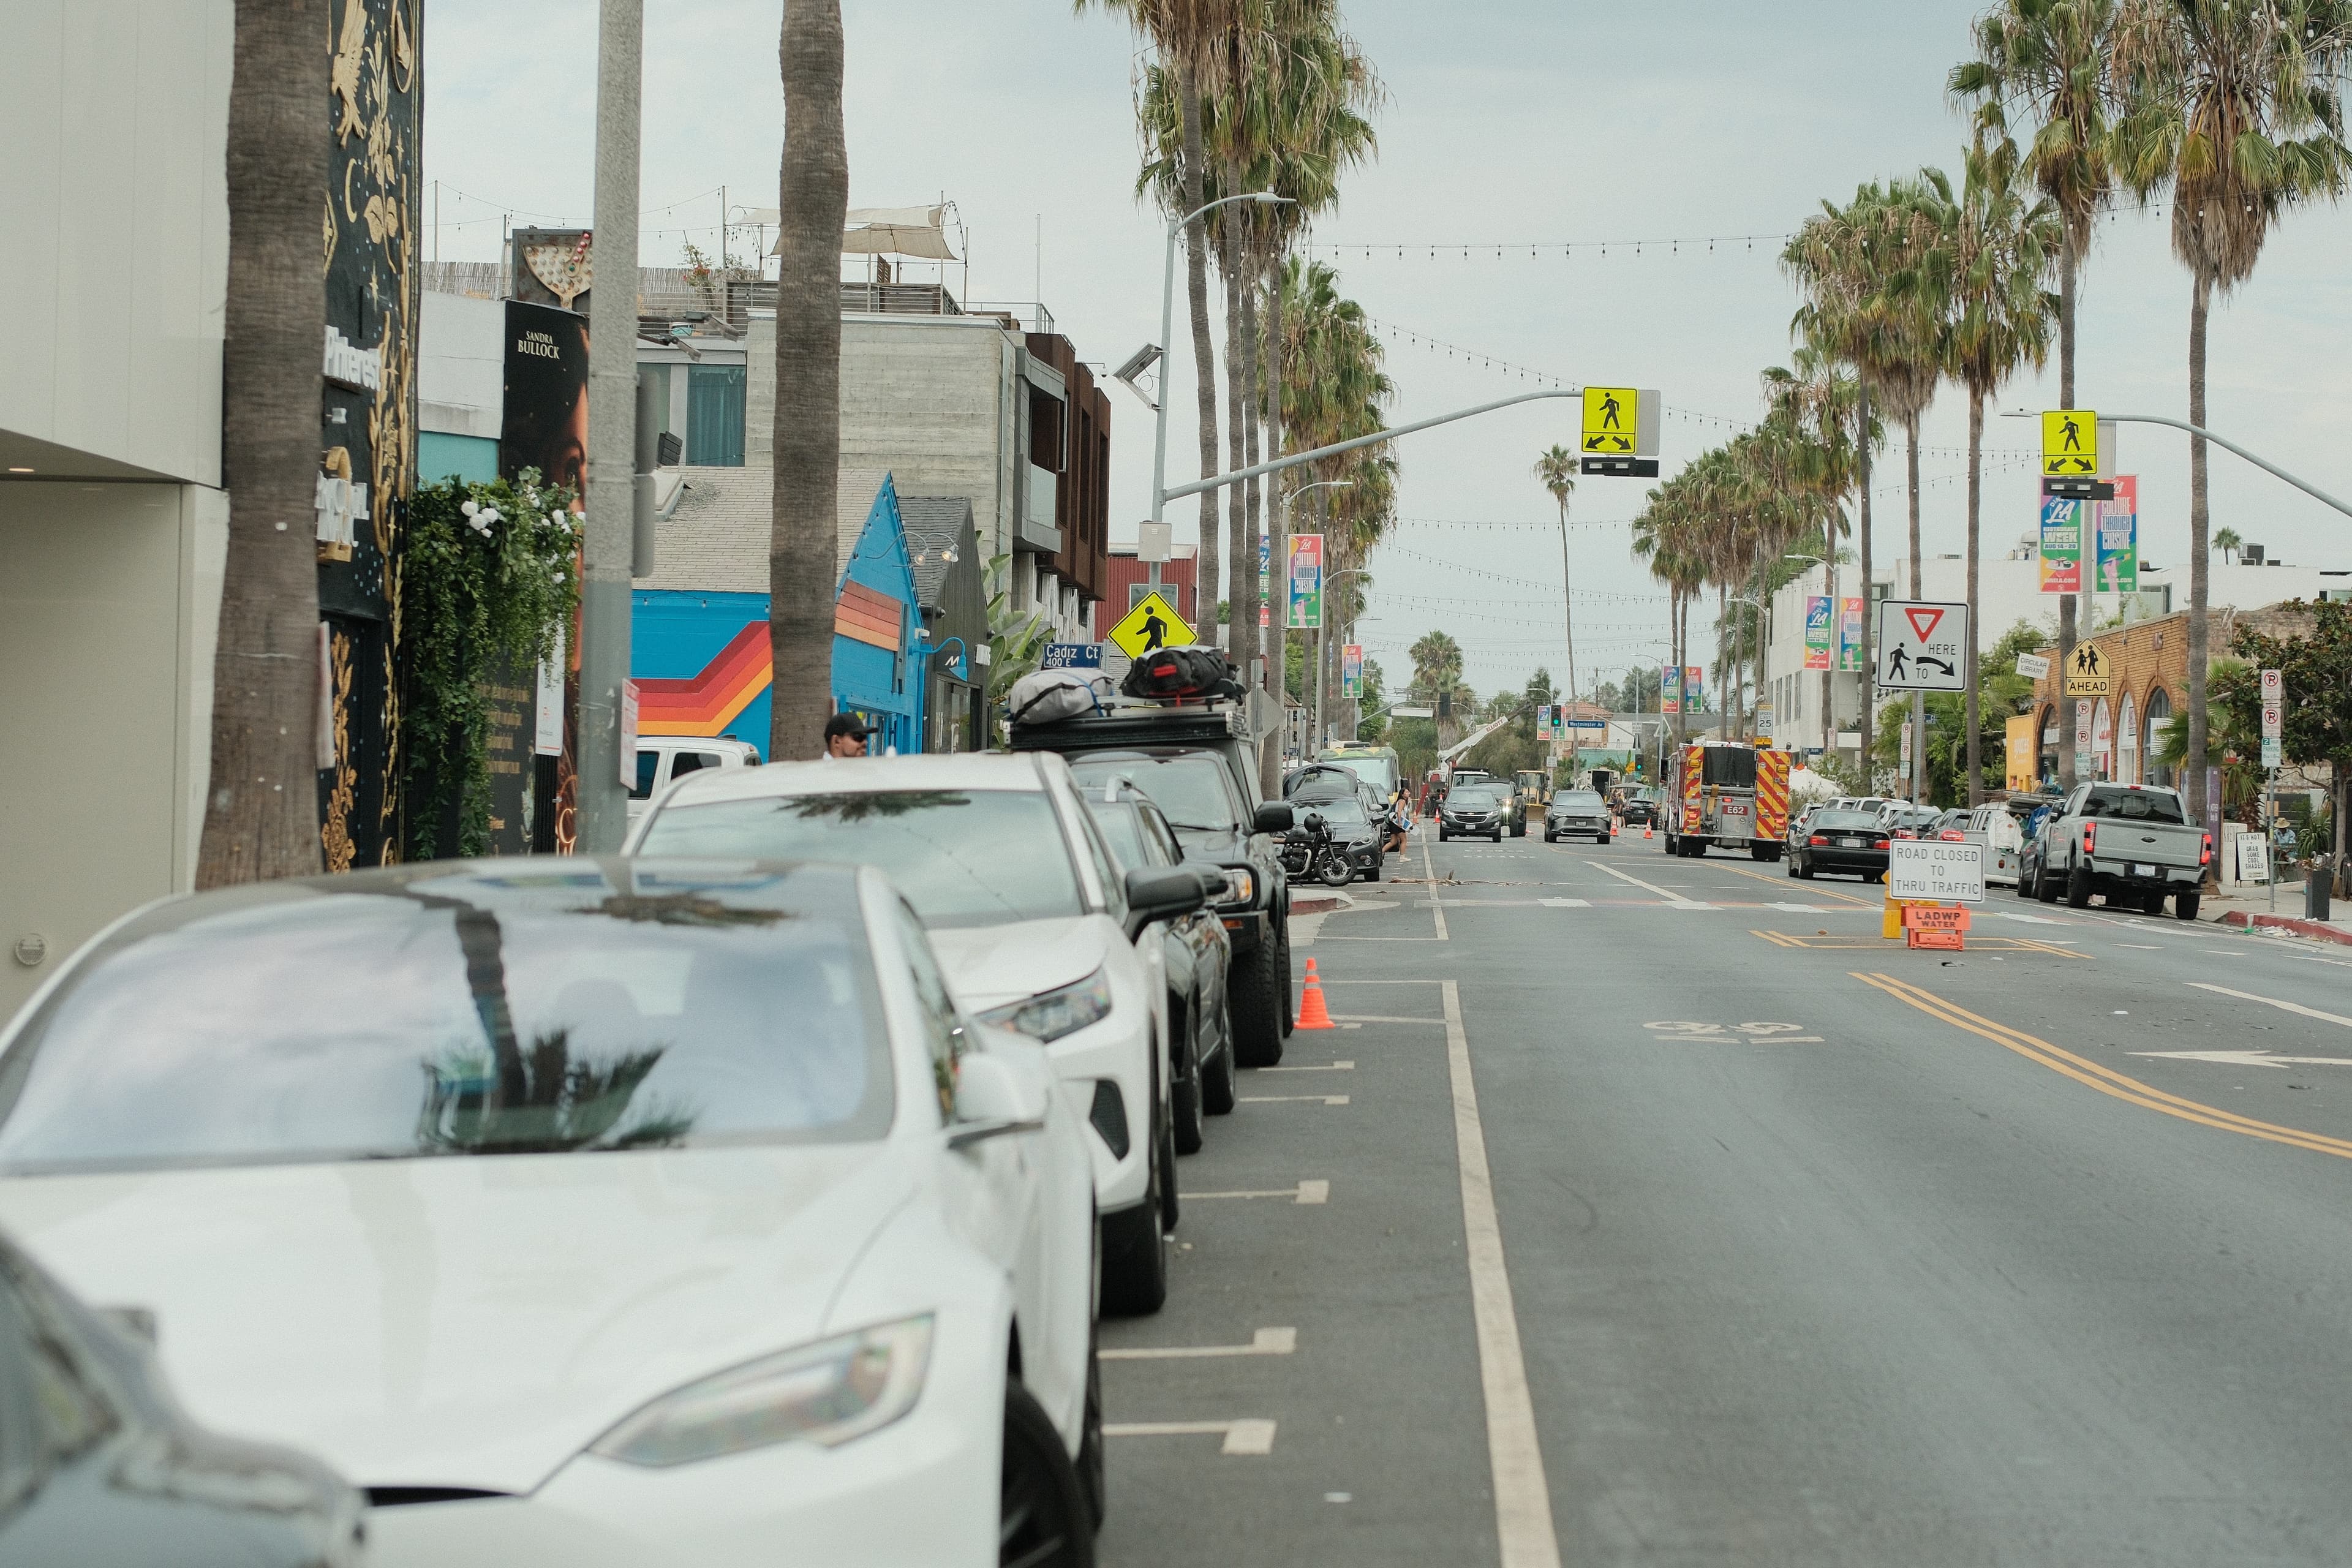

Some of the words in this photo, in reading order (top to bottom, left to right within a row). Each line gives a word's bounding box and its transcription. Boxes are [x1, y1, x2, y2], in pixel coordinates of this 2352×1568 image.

[526, 331, 553, 344] SANDRA
[518, 339, 560, 360] BULLOCK
[2045, 501, 2075, 523] LA
[2101, 497, 2131, 514] CULTURE
[2102, 516, 2130, 531] THROUGH
[2043, 532, 2078, 543] WEEK
[2103, 532, 2131, 550] CUISINE
[1300, 540, 1312, 550] LA
[1294, 552, 1317, 566] CULTURE
[1295, 567, 1316, 579] THROUGH
[1295, 579, 1316, 594] CUISINE
[1809, 612, 1828, 626] LA
[1046, 644, 1077, 658] Cadiz
[1086, 646, 1098, 659] Ct
[1928, 644, 1957, 655] HERE
[1046, 658, 1063, 666] 400
[1066, 658, 1071, 667] E
[2020, 657, 2047, 669] CIRCULAR
[1916, 668, 1928, 679] TO
[2021, 666, 2044, 674] LIBRARY
[2069, 682, 2107, 692] AHEAD
[1486, 719, 1503, 732] ELLIOTT
[1897, 848, 1928, 859] ROAD
[1934, 849, 1978, 862] CLOSED
[1931, 865, 1945, 876] TO
[1896, 880, 1926, 892] THRU
[1931, 881, 1979, 895] TRAFFIC
[1915, 911, 1961, 920] LADWP
